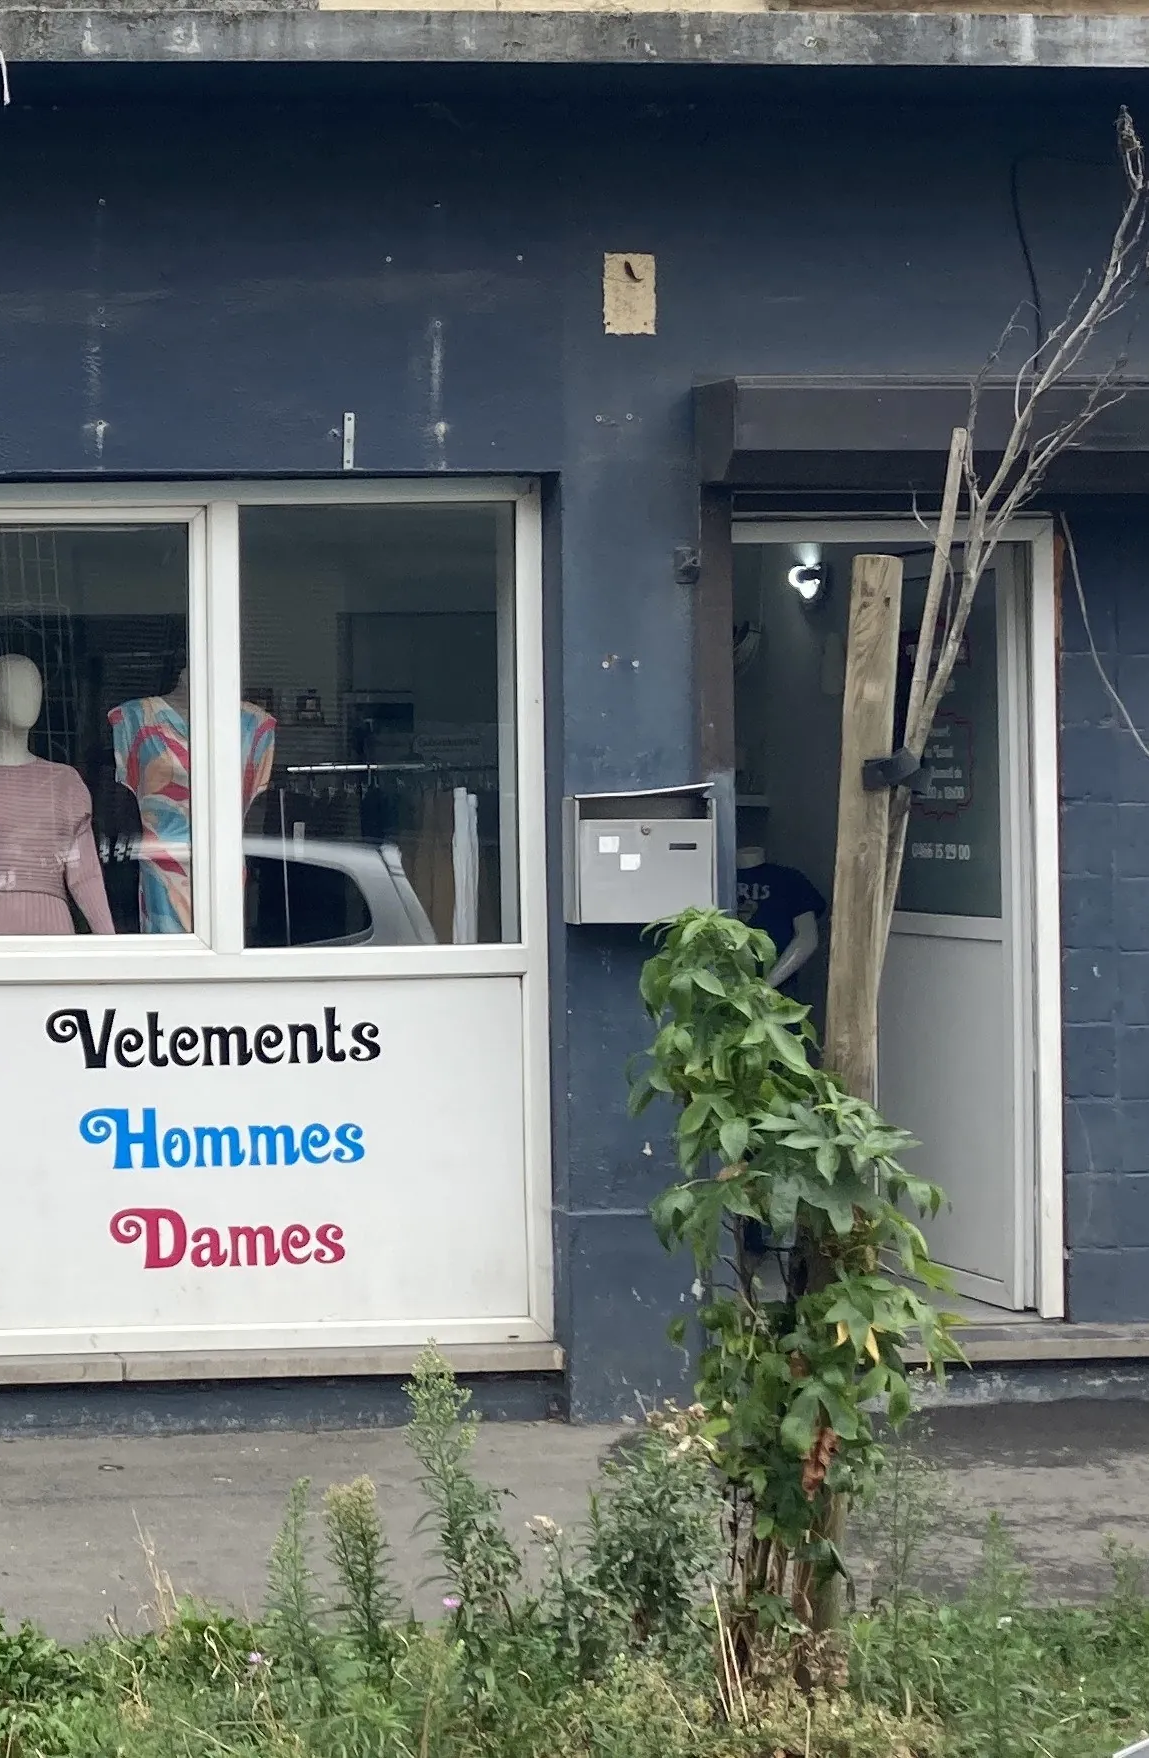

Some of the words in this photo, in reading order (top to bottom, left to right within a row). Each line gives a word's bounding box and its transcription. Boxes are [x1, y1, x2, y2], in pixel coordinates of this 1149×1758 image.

[45, 1006, 381, 1069] Vetements
[79, 1107, 365, 1169] Hommes
[110, 1208, 346, 1269] Dames
